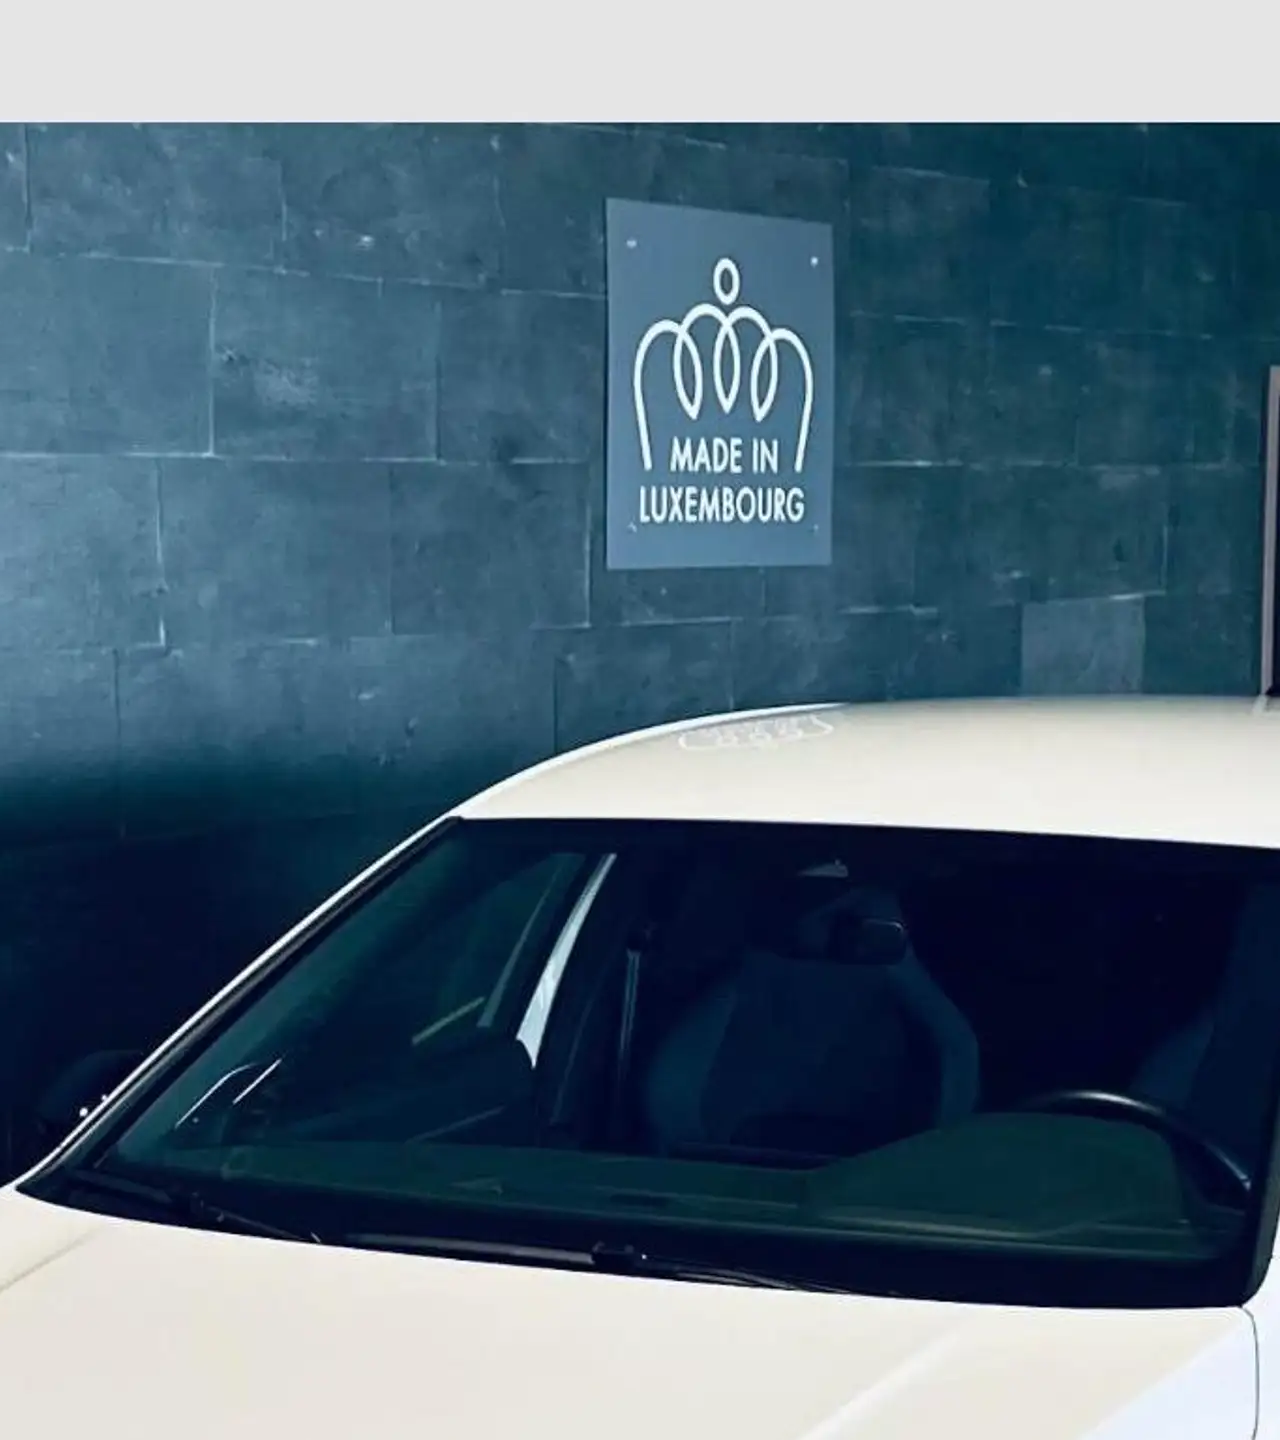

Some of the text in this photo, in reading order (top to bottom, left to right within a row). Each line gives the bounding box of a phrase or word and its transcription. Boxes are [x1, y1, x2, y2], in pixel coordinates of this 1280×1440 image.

[670, 436, 779, 474] MADE IN
[639, 486, 805, 523] LUXEMBOURG
